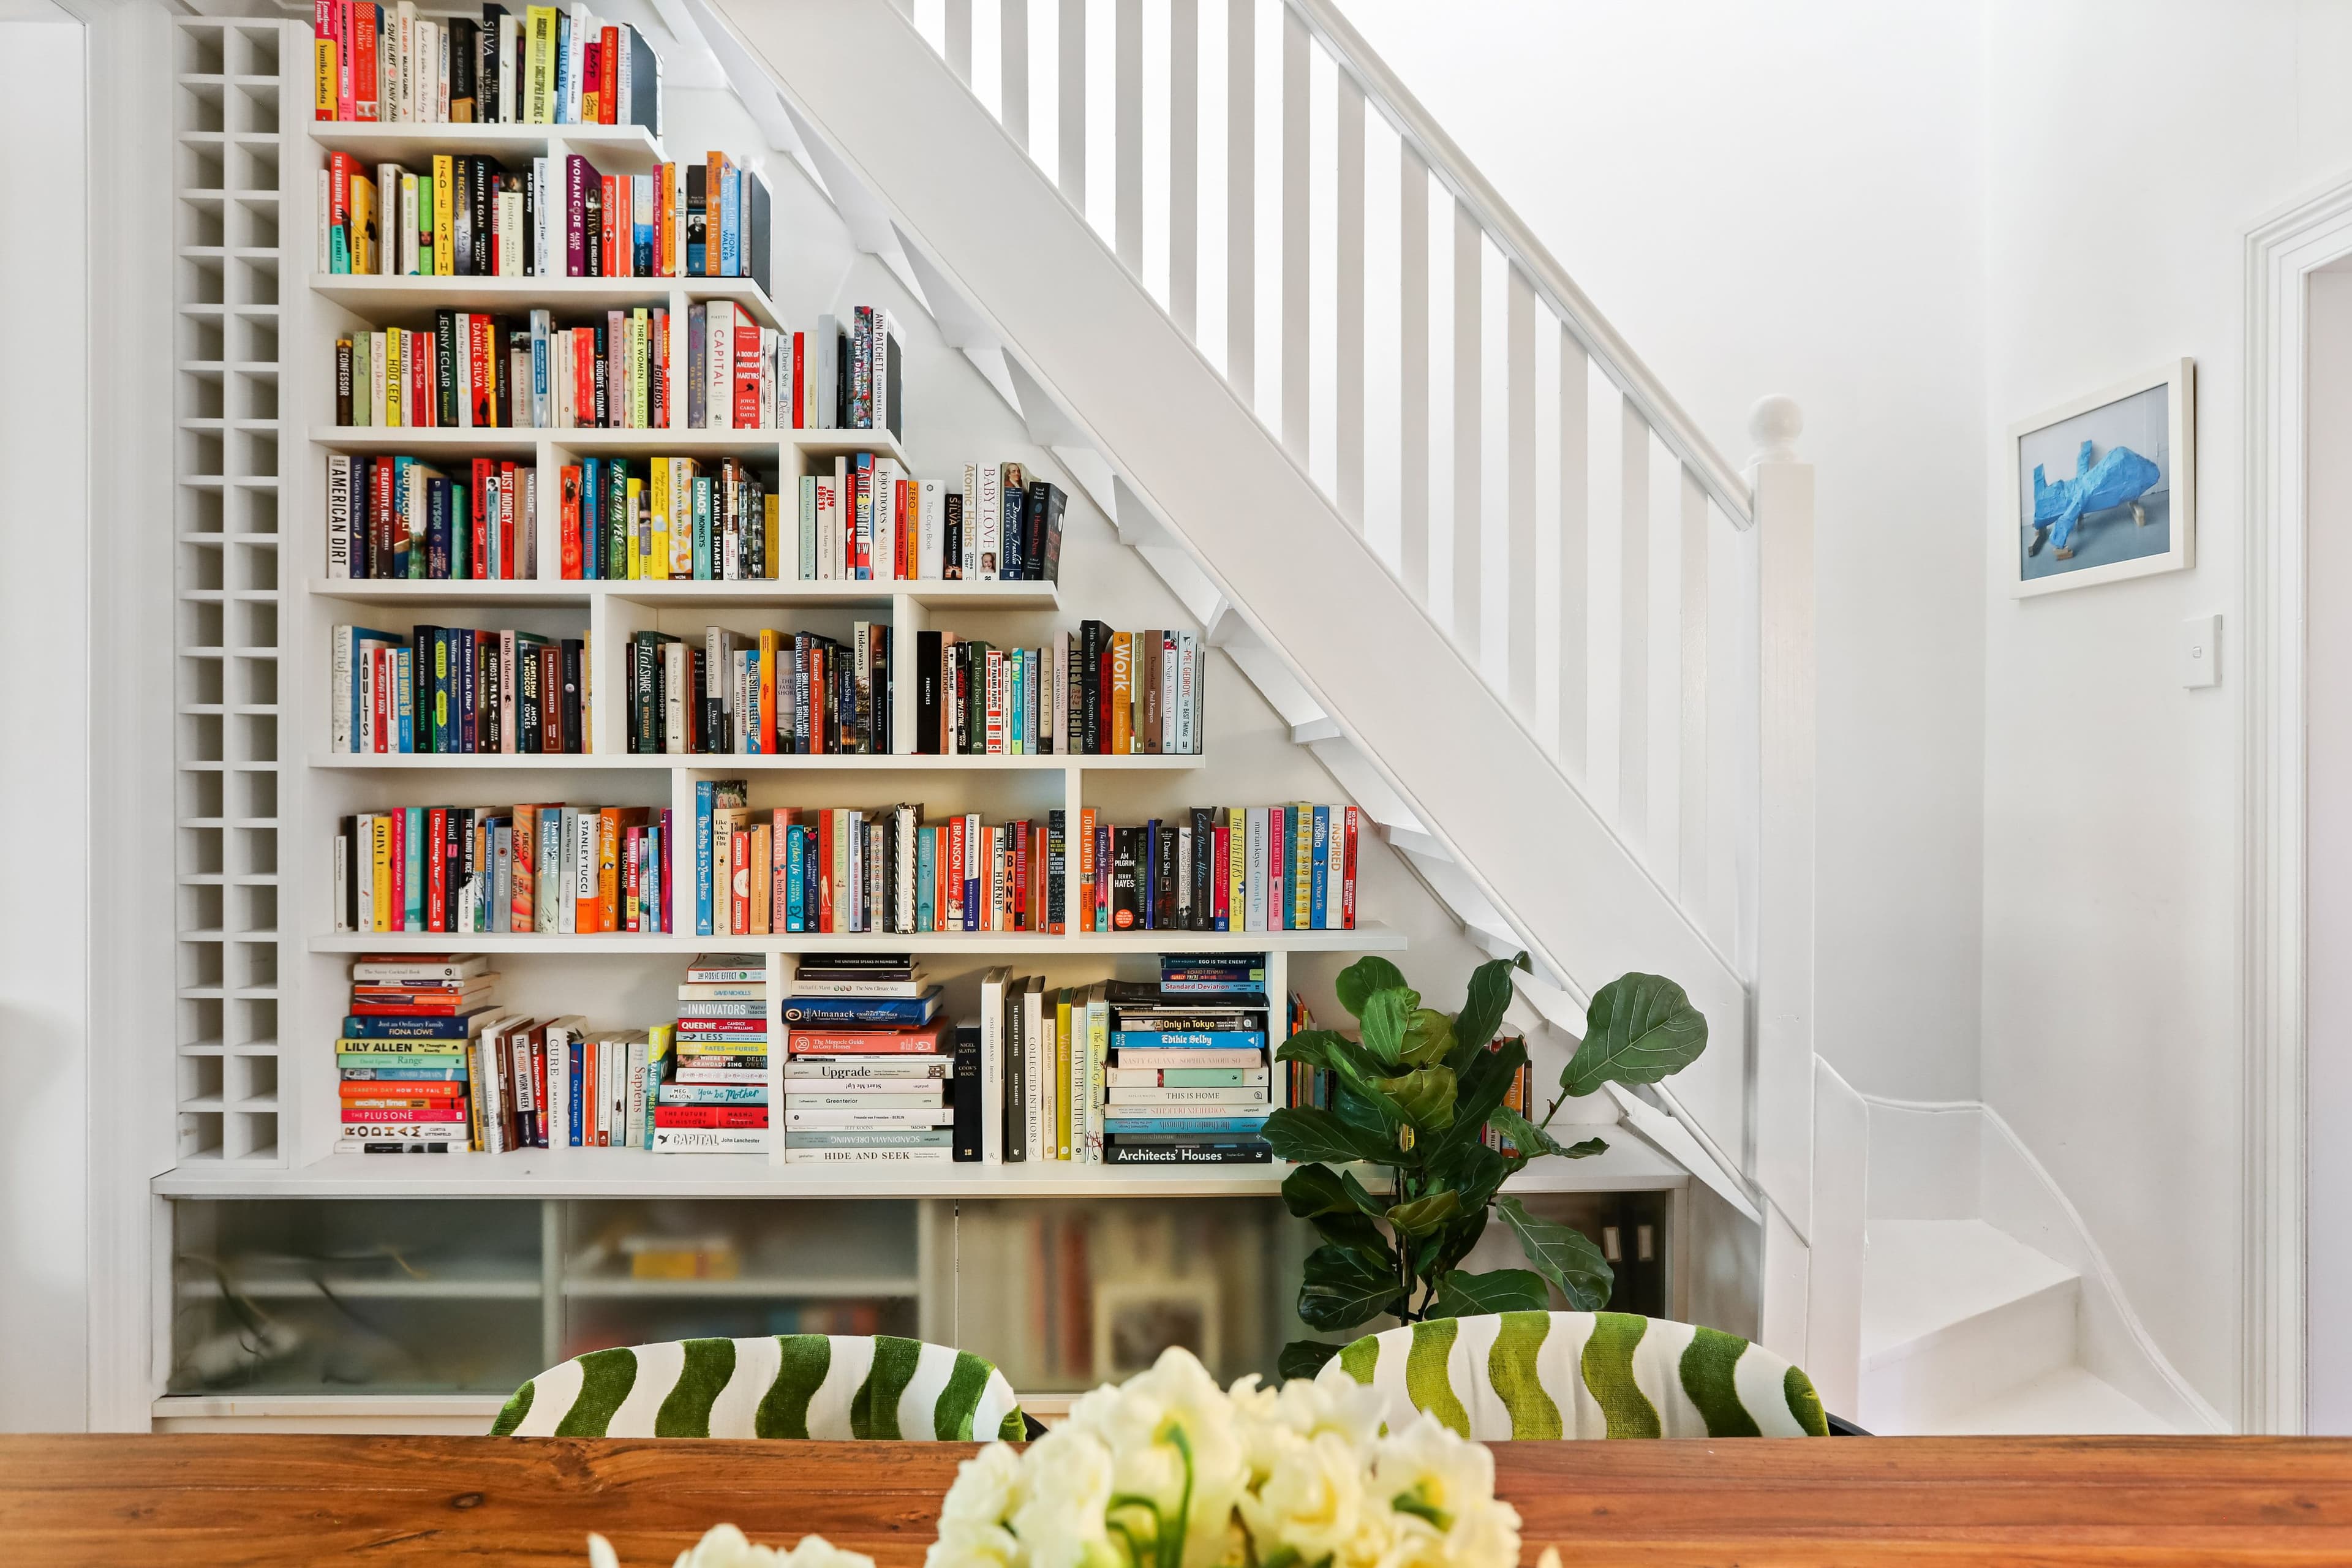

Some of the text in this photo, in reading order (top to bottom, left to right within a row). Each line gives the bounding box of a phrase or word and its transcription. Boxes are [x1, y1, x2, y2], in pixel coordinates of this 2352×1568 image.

[484, 21, 494, 55] SILVA
[439, 223, 449, 271] SMITH
[440, 315, 450, 386] JENNY ECLAIR
[473, 323, 481, 358] DANIEL
[714, 330, 724, 386] CAPITAL
[340, 353, 349, 396] CONFESSOR
[380, 468, 389, 508] CREATIVITY,
[502, 471, 513, 524] JUST MONEY
[612, 464, 624, 543] ASK AGAIN, YES
[697, 481, 706, 514] CHAOS
[877, 470, 890, 523] jojo moyes
[965, 465, 974, 547] Atomic Habits
[332, 469, 346, 565] AMERICAN DIRT
[949, 497, 957, 526] SILVA
[983, 469, 995, 548] BABY LOVE
[1114, 644, 1129, 691] Work
[448, 818, 457, 839] maid
[775, 823, 784, 860] switch
[1314, 816, 1323, 847] kinsella
[1332, 823, 1341, 871] INSPIRED
[952, 826, 962, 869] BRANSON
[1232, 818, 1242, 878] THE JETSETTERS
[1253, 848, 1261, 867] keyes
[775, 897, 784, 921] o'leary
[688, 1005, 745, 1015] INNOVATORS
[1164, 1020, 1182, 1030] Only
[1192, 1020, 1215, 1030] Tokyo
[345, 1043, 369, 1052] LILY
[398, 1056, 423, 1065] Range
[517, 1050, 526, 1072] 4-HOUR
[549, 1039, 559, 1076] CURE
[631, 1067, 646, 1112] Sapiens
[822, 1067, 870, 1079] Upgrade
[520, 1092, 529, 1109] WEEK
[673, 1134, 719, 1145] CAPITAL
[1118, 1149, 1222, 1161] Architects' Houses
